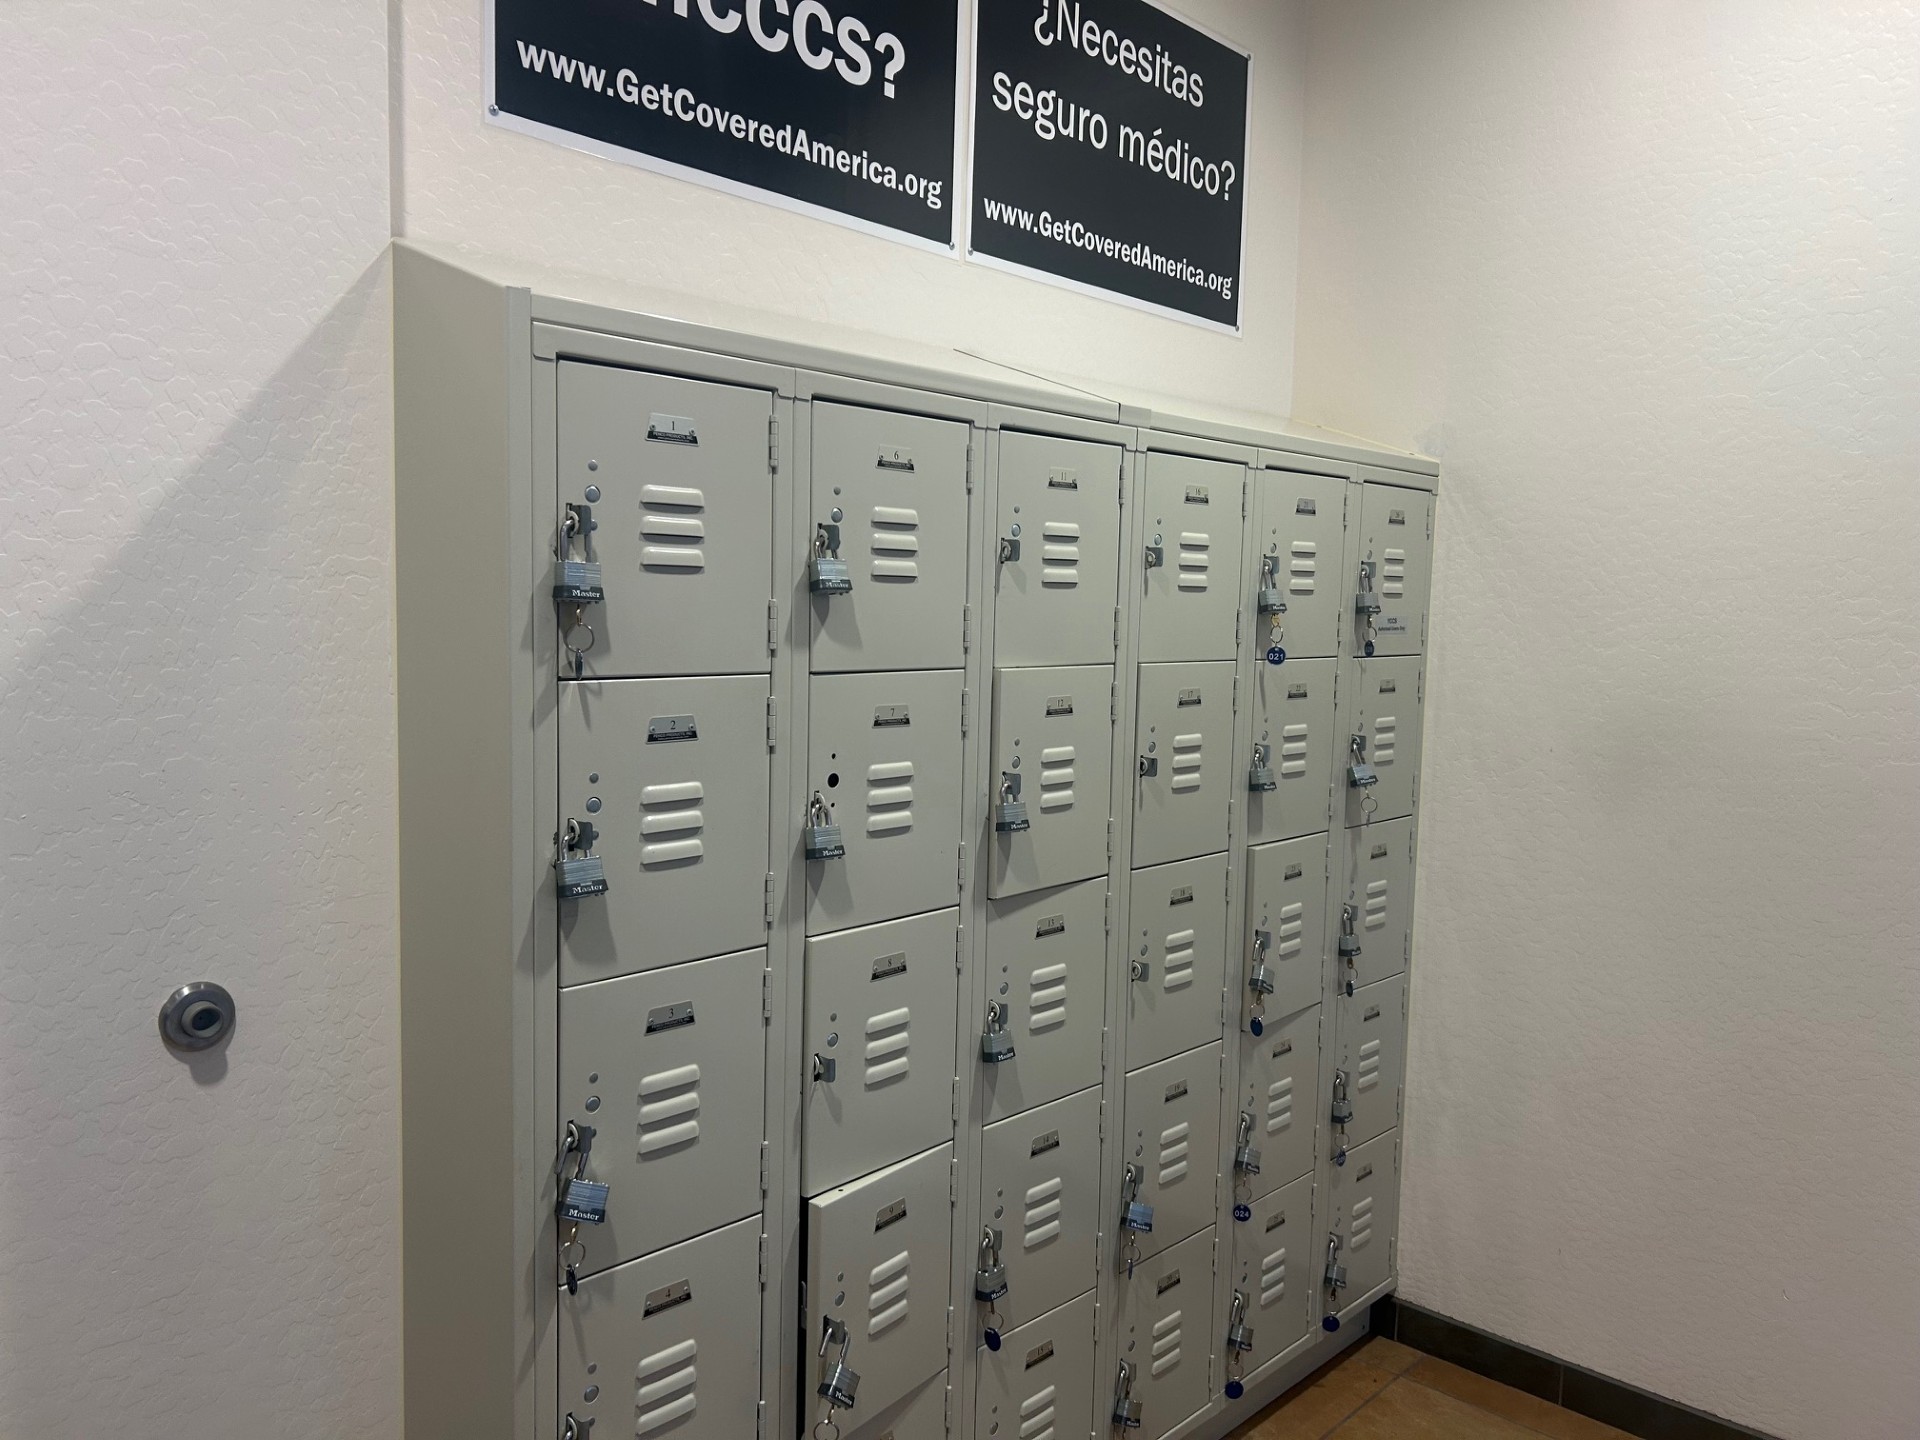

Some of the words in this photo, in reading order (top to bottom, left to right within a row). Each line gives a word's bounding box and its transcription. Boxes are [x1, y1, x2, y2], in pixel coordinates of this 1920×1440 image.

[642, 0, 905, 99] CCS?
[1033, 0, 1204, 108] ¿Necesitas
[516, 39, 943, 210] www.GetCoveredAmerica.org
[992, 71, 1108, 150] seguro
[1118, 124, 1236, 201] médico?
[984, 197, 1232, 300] www.GetCoveredAmerica.org
[893, 450, 899, 460] 6
[572, 589, 600, 598] Master
[1268, 652, 1284, 661] 021
[1057, 699, 1064, 708] 12
[890, 707, 895, 717] 7
[670, 720, 676, 730] 2
[822, 849, 843, 857] Master
[572, 885, 603, 894] Master
[887, 958, 892, 968] 8
[668, 1008, 674, 1019] 3
[568, 1208, 600, 1221] Master
[1234, 1209, 1249, 1218] 024
[665, 1289, 671, 1299] 4
[991, 1287, 1007, 1300] Master
